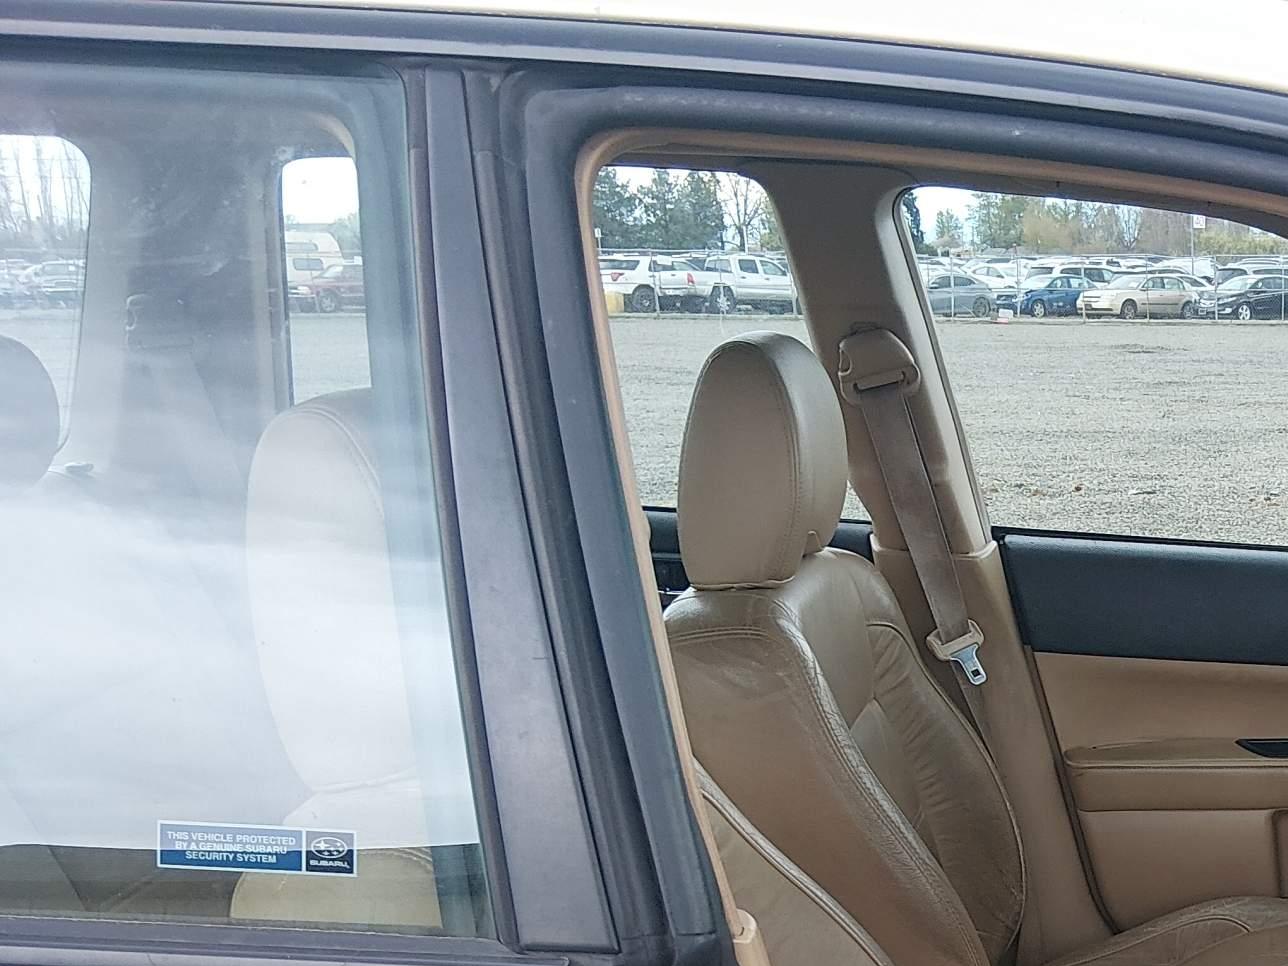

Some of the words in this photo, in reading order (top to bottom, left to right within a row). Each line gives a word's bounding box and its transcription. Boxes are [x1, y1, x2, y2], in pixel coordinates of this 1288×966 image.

[167, 831, 189, 841] THIS
[191, 832, 233, 843] VEHICLE
[236, 834, 296, 846] PROTECTED
[175, 841, 187, 850] BY
[190, 841, 200, 850] A
[200, 842, 243, 852] GENUINE
[245, 844, 287, 854] SUBARU
[185, 851, 234, 861] SECURITY
[236, 852, 277, 863] SYSTEM
[309, 859, 350, 868] SUBARU
